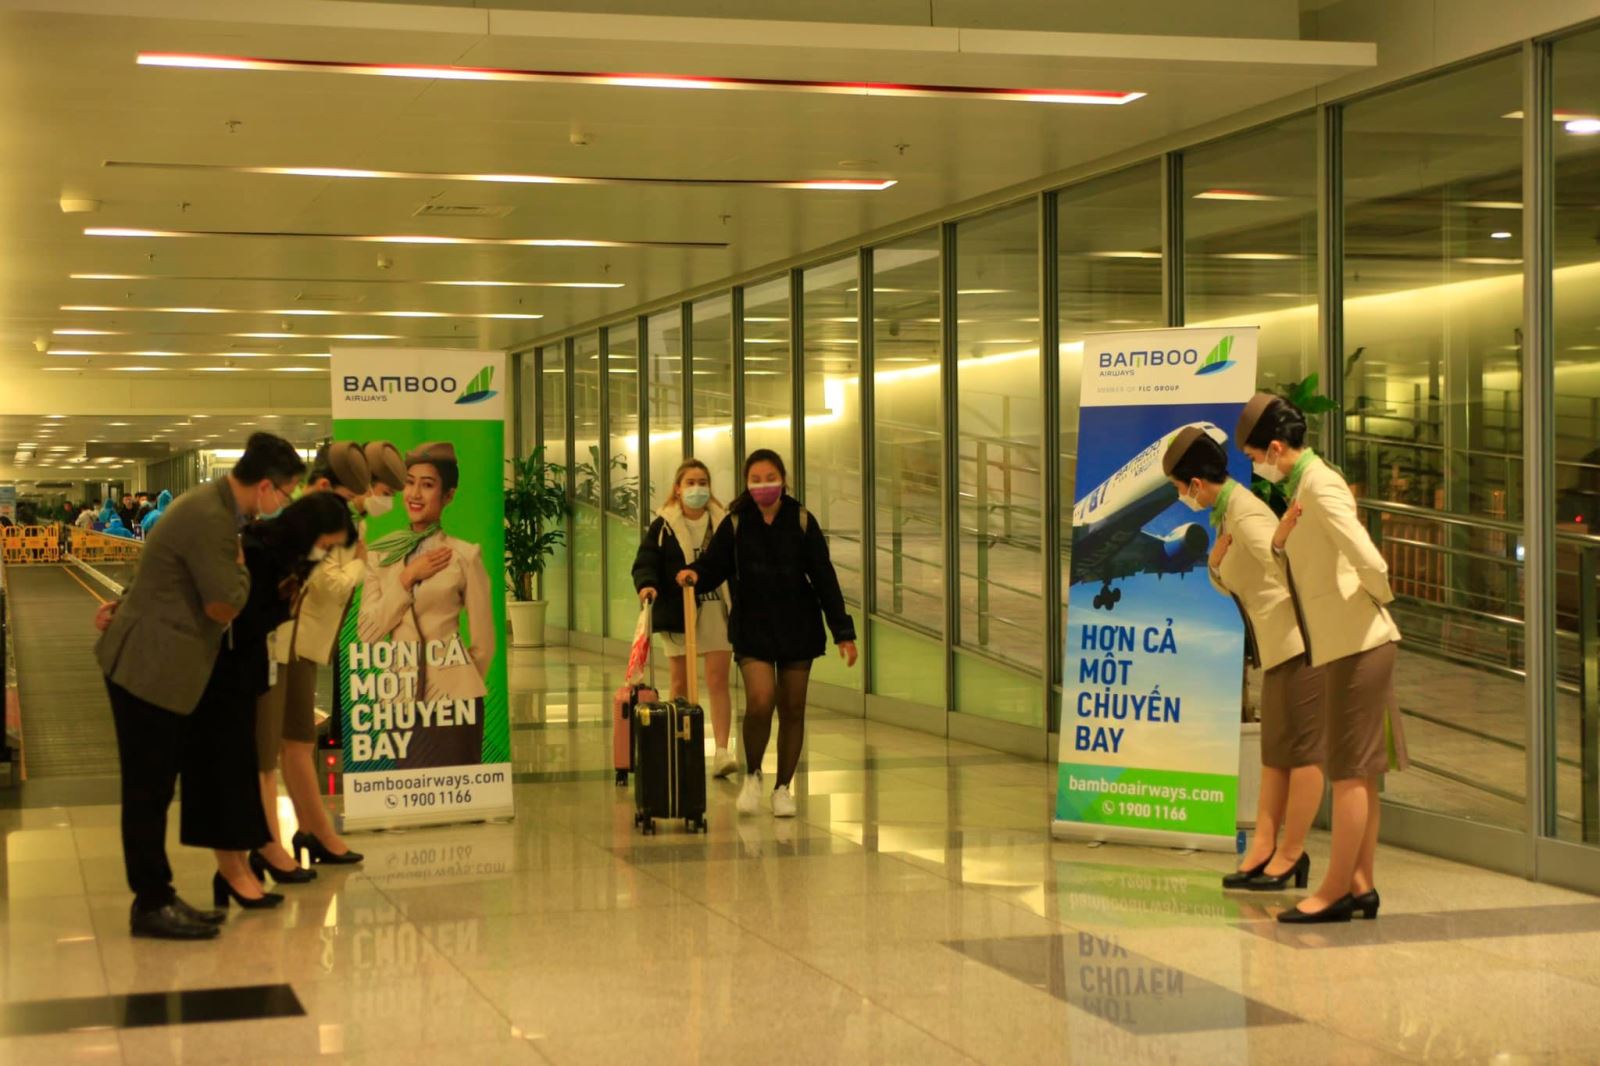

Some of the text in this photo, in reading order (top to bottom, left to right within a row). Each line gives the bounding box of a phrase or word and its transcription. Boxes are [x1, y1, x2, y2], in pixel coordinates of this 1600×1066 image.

[1099, 348, 1198, 368] BAMBOO
[343, 375, 457, 394] BAMBOO
[1099, 369, 1135, 377] AIRWAYS
[1154, 384, 1180, 392] GROUP
[1081, 617, 1177, 654] HƠN CẢ
[349, 633, 467, 669] HƠN CẢ
[1079, 652, 1133, 692] MỘT
[1077, 684, 1181, 723] CHUYẾN
[351, 731, 413, 762] BAY
[1075, 724, 1124, 753] BAY
[353, 772, 504, 793] bambooairways.com
[1068, 774, 1224, 803] bambooairways.com
[402, 790, 472, 807] 1900 1166
[1118, 802, 1187, 821] 1900 1166
